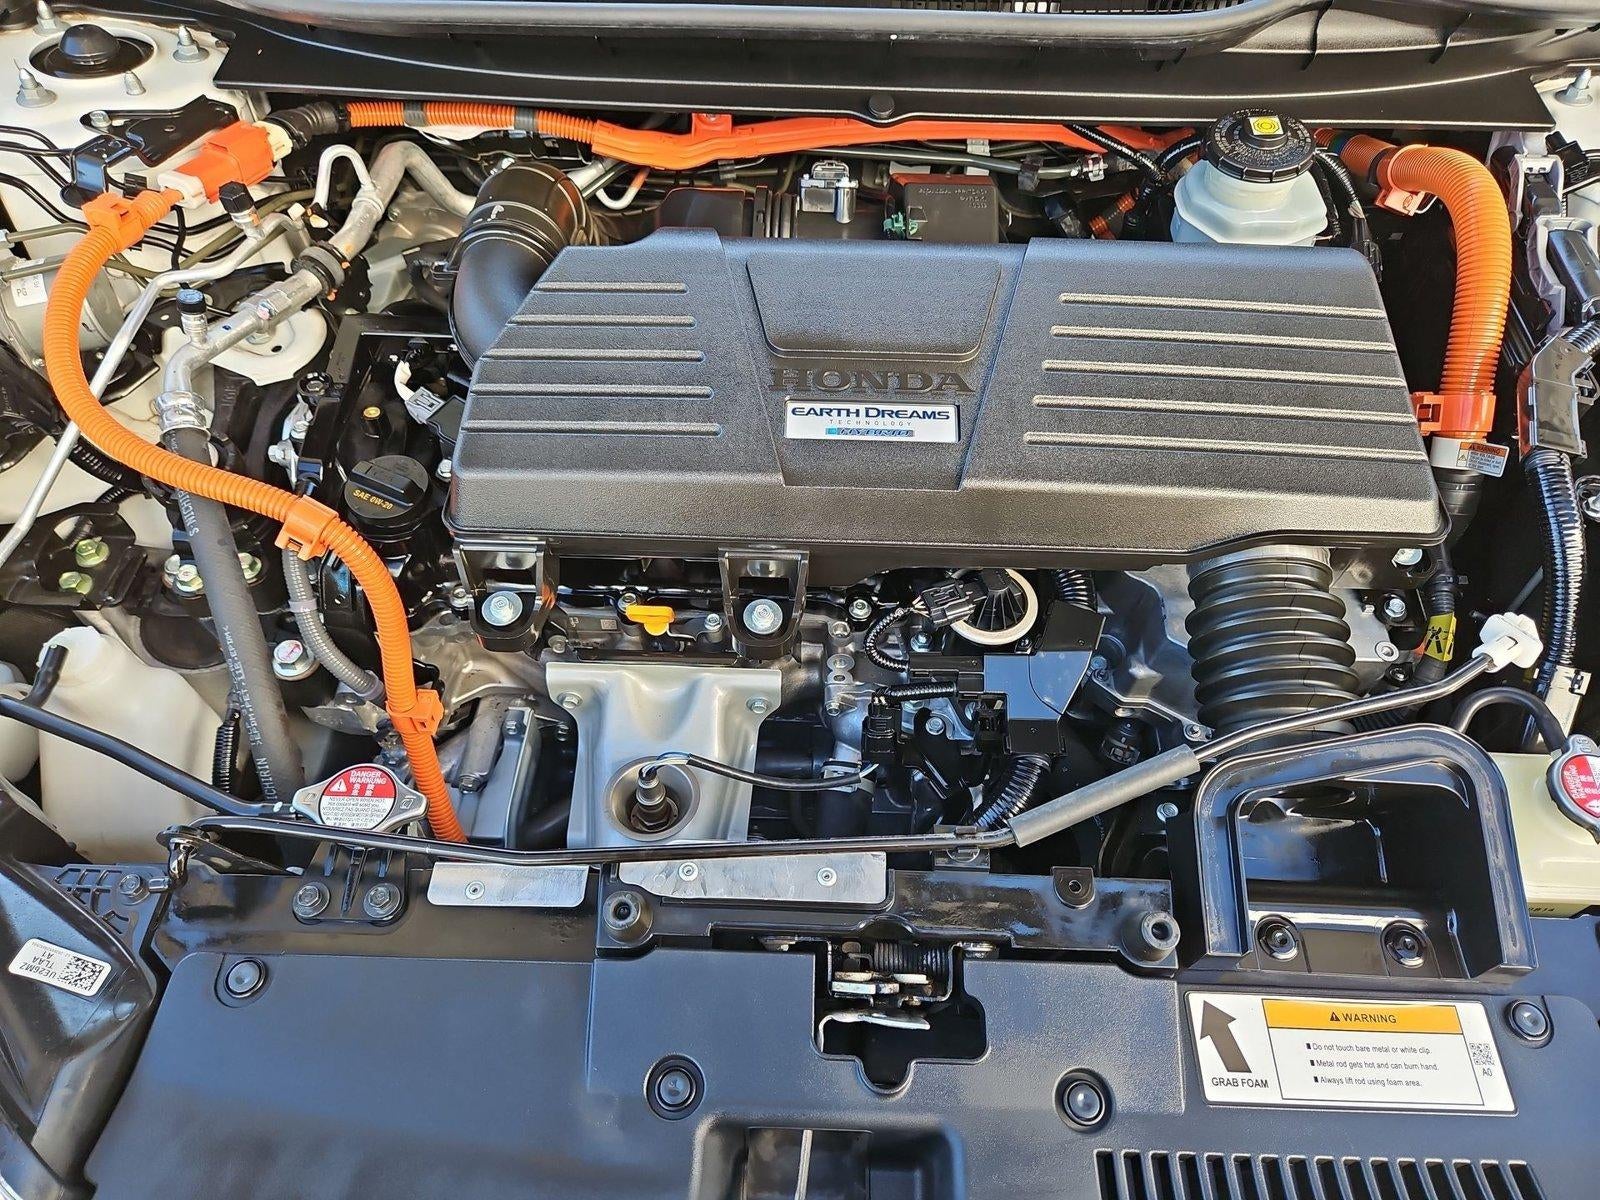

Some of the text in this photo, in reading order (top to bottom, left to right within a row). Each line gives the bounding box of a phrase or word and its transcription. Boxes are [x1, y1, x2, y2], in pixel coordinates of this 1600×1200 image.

[769, 368, 976, 394] HONDA
[791, 406, 950, 420] EARTH DREAMS
[352, 488, 395, 510] SAE 0W-20
[350, 770, 383, 778] DANGER
[32, 955, 55, 969] TLAA
[1342, 1012, 1397, 1024] WARNING
[1312, 1042, 1323, 1051] Do
[1335, 1044, 1354, 1052] touch
[1355, 1044, 1371, 1052] bare
[1371, 1045, 1391, 1053] metal
[1400, 1046, 1418, 1054] white
[1418, 1046, 1433, 1055] clip.
[1315, 1059, 1335, 1068] Metal
[1336, 1060, 1348, 1068] rod
[1348, 1061, 1363, 1069] gets
[1364, 1061, 1375, 1069] hot
[1403, 1062, 1420, 1070] burn
[1420, 1062, 1440, 1071] hand.
[1211, 1076, 1269, 1089] GRAB FOAM
[1320, 1076, 1344, 1085] Always
[1345, 1077, 1354, 1085] lift
[1367, 1077, 1386, 1087] using
[1386, 1078, 1404, 1086] foam
